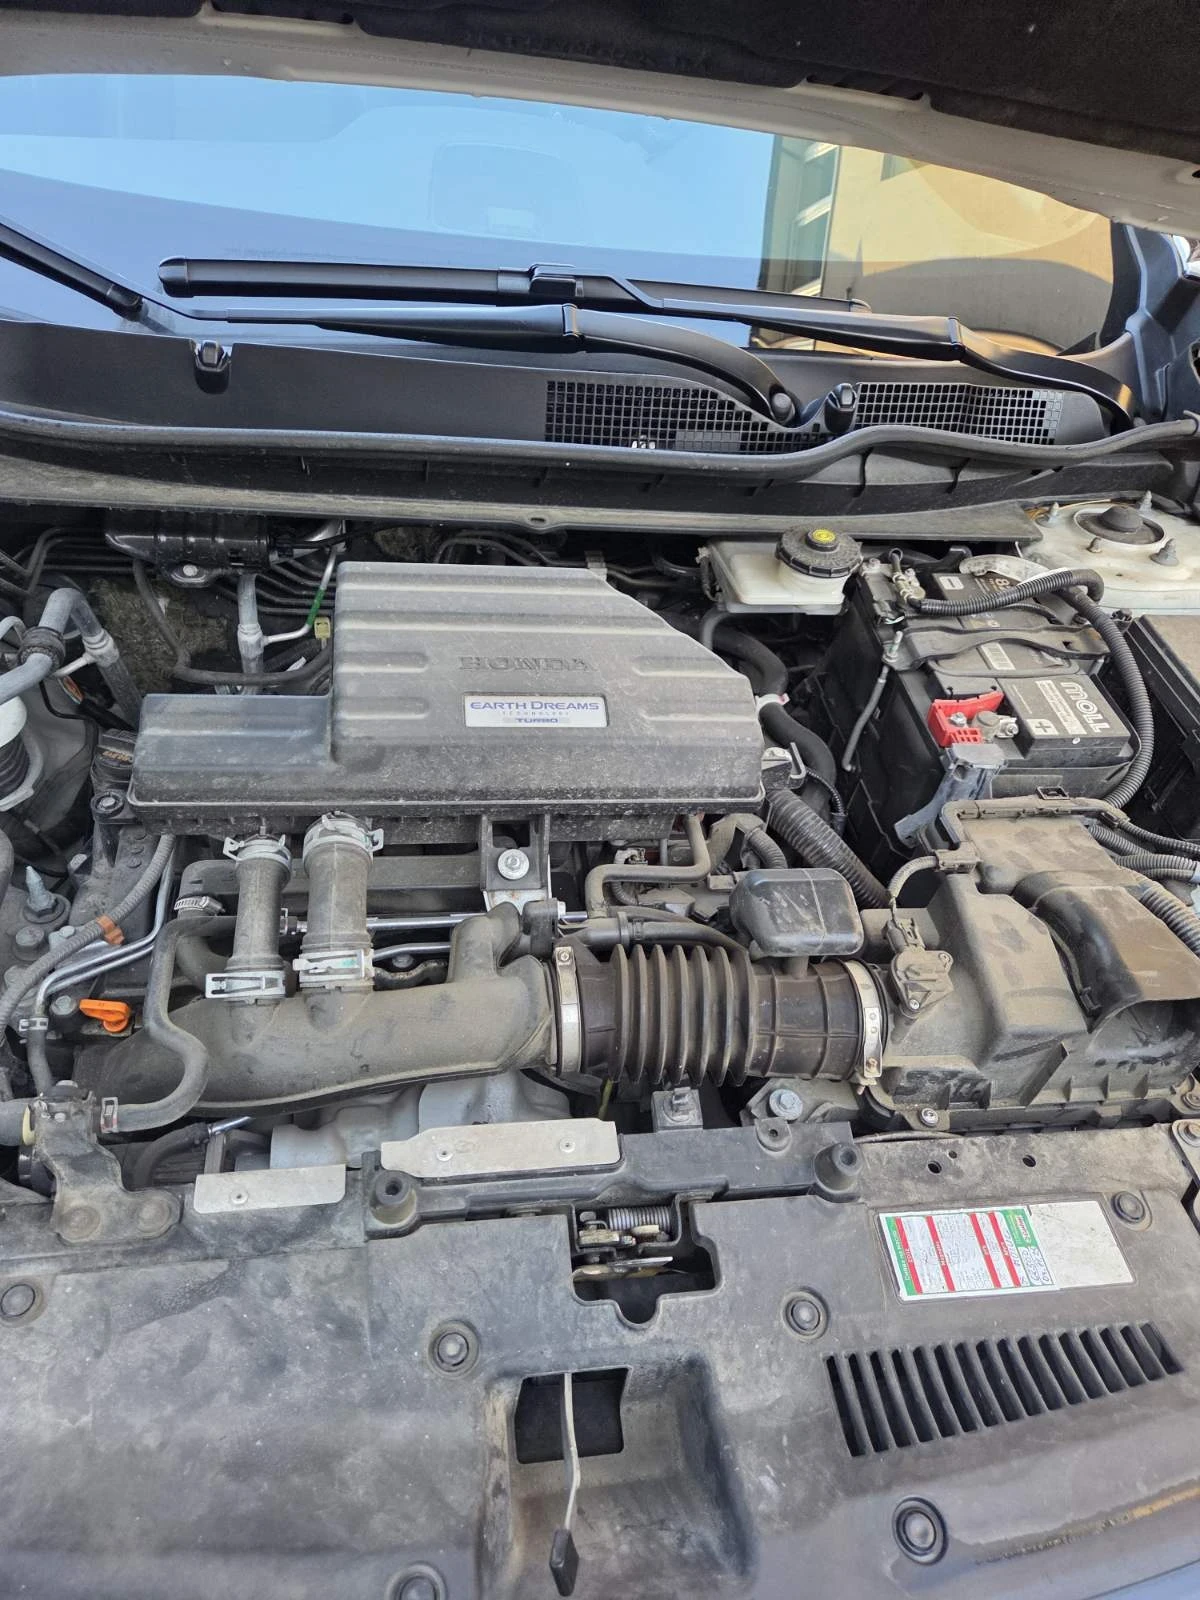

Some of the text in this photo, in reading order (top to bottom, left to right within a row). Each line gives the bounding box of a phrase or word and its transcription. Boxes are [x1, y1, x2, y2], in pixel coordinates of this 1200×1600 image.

[458, 656, 599, 672] HONDA
[470, 701, 600, 710] EARTH DREAMS
